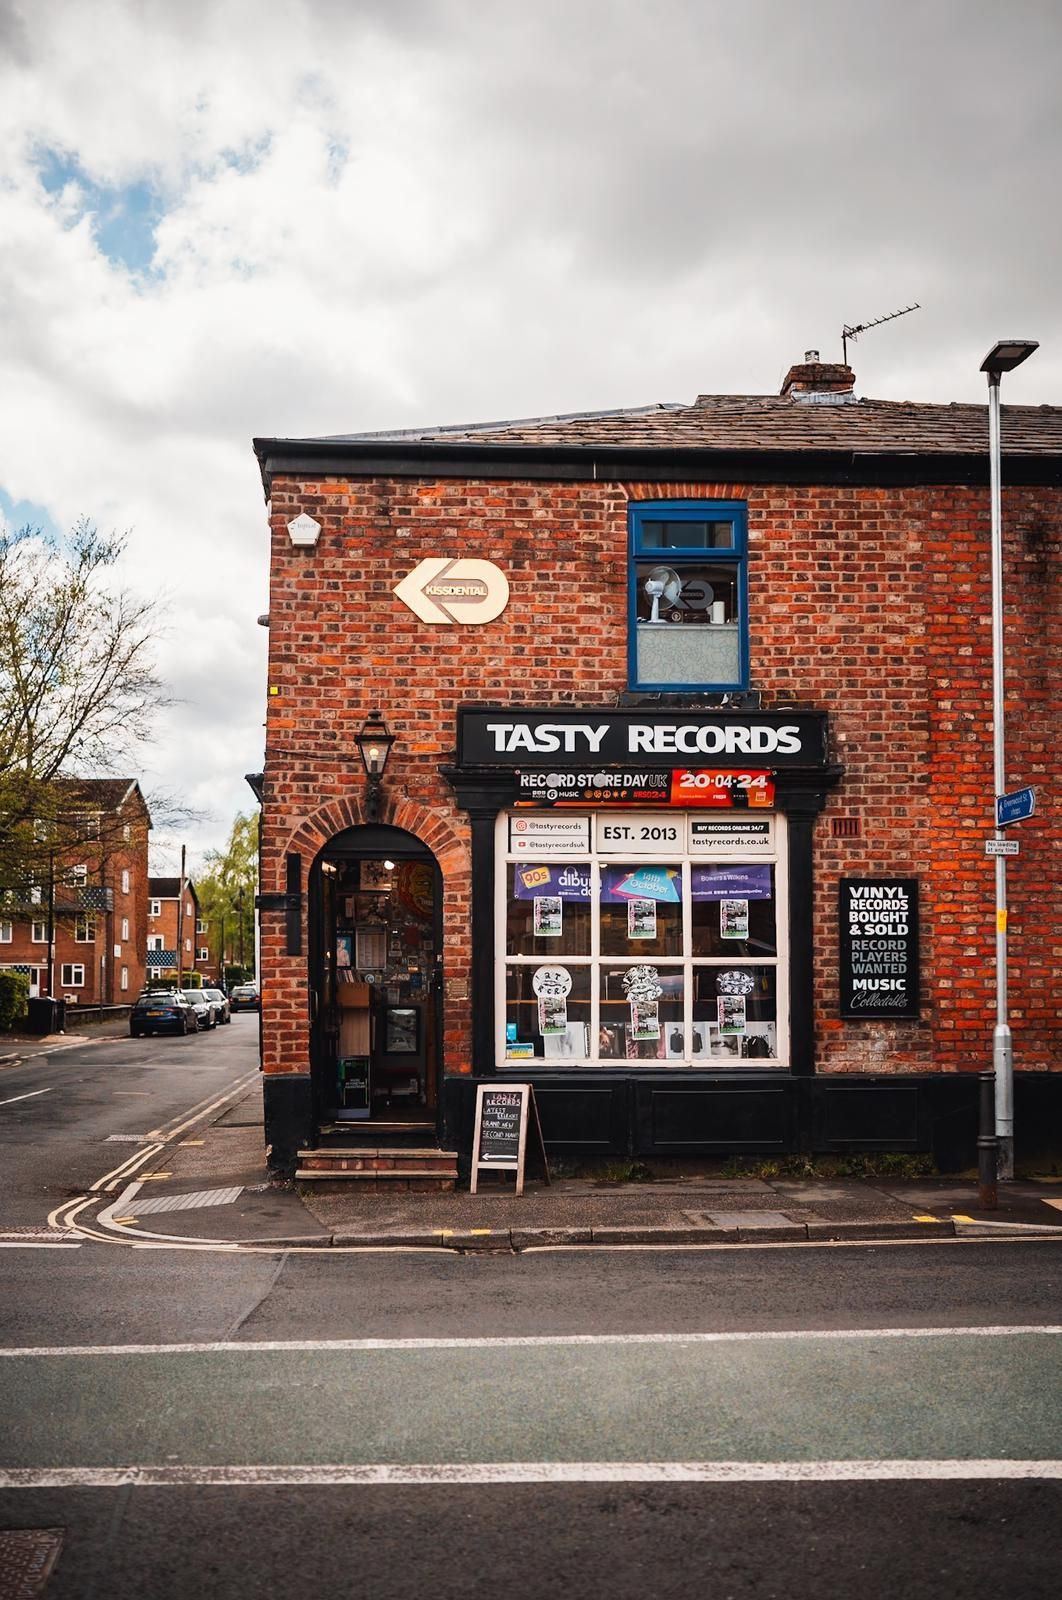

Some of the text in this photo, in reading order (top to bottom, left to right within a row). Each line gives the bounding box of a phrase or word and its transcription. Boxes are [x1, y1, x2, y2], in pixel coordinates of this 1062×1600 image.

[425, 586, 488, 596] KISSDENTAL
[486, 723, 802, 754] TASTY RECORDS
[520, 773, 668, 788] RECORD STORE DAY UK
[529, 822, 582, 831] @tastyrecords
[603, 826, 677, 841] EST. 2013
[529, 841, 585, 849] @tastyrecordsuk
[692, 837, 770, 847] tastyrecords.co.uk
[524, 871, 548, 884] 90s
[630, 879, 669, 894] October
[849, 886, 909, 899] VINYL
[849, 898, 909, 911] RECORDS
[849, 911, 909, 923] BOUGHT
[849, 923, 909, 936] & SOLD
[851, 940, 907, 951] RECORD
[851, 951, 908, 963] PLAYERS
[851, 963, 907, 974] WANTED
[852, 978, 907, 991] MUSIC
